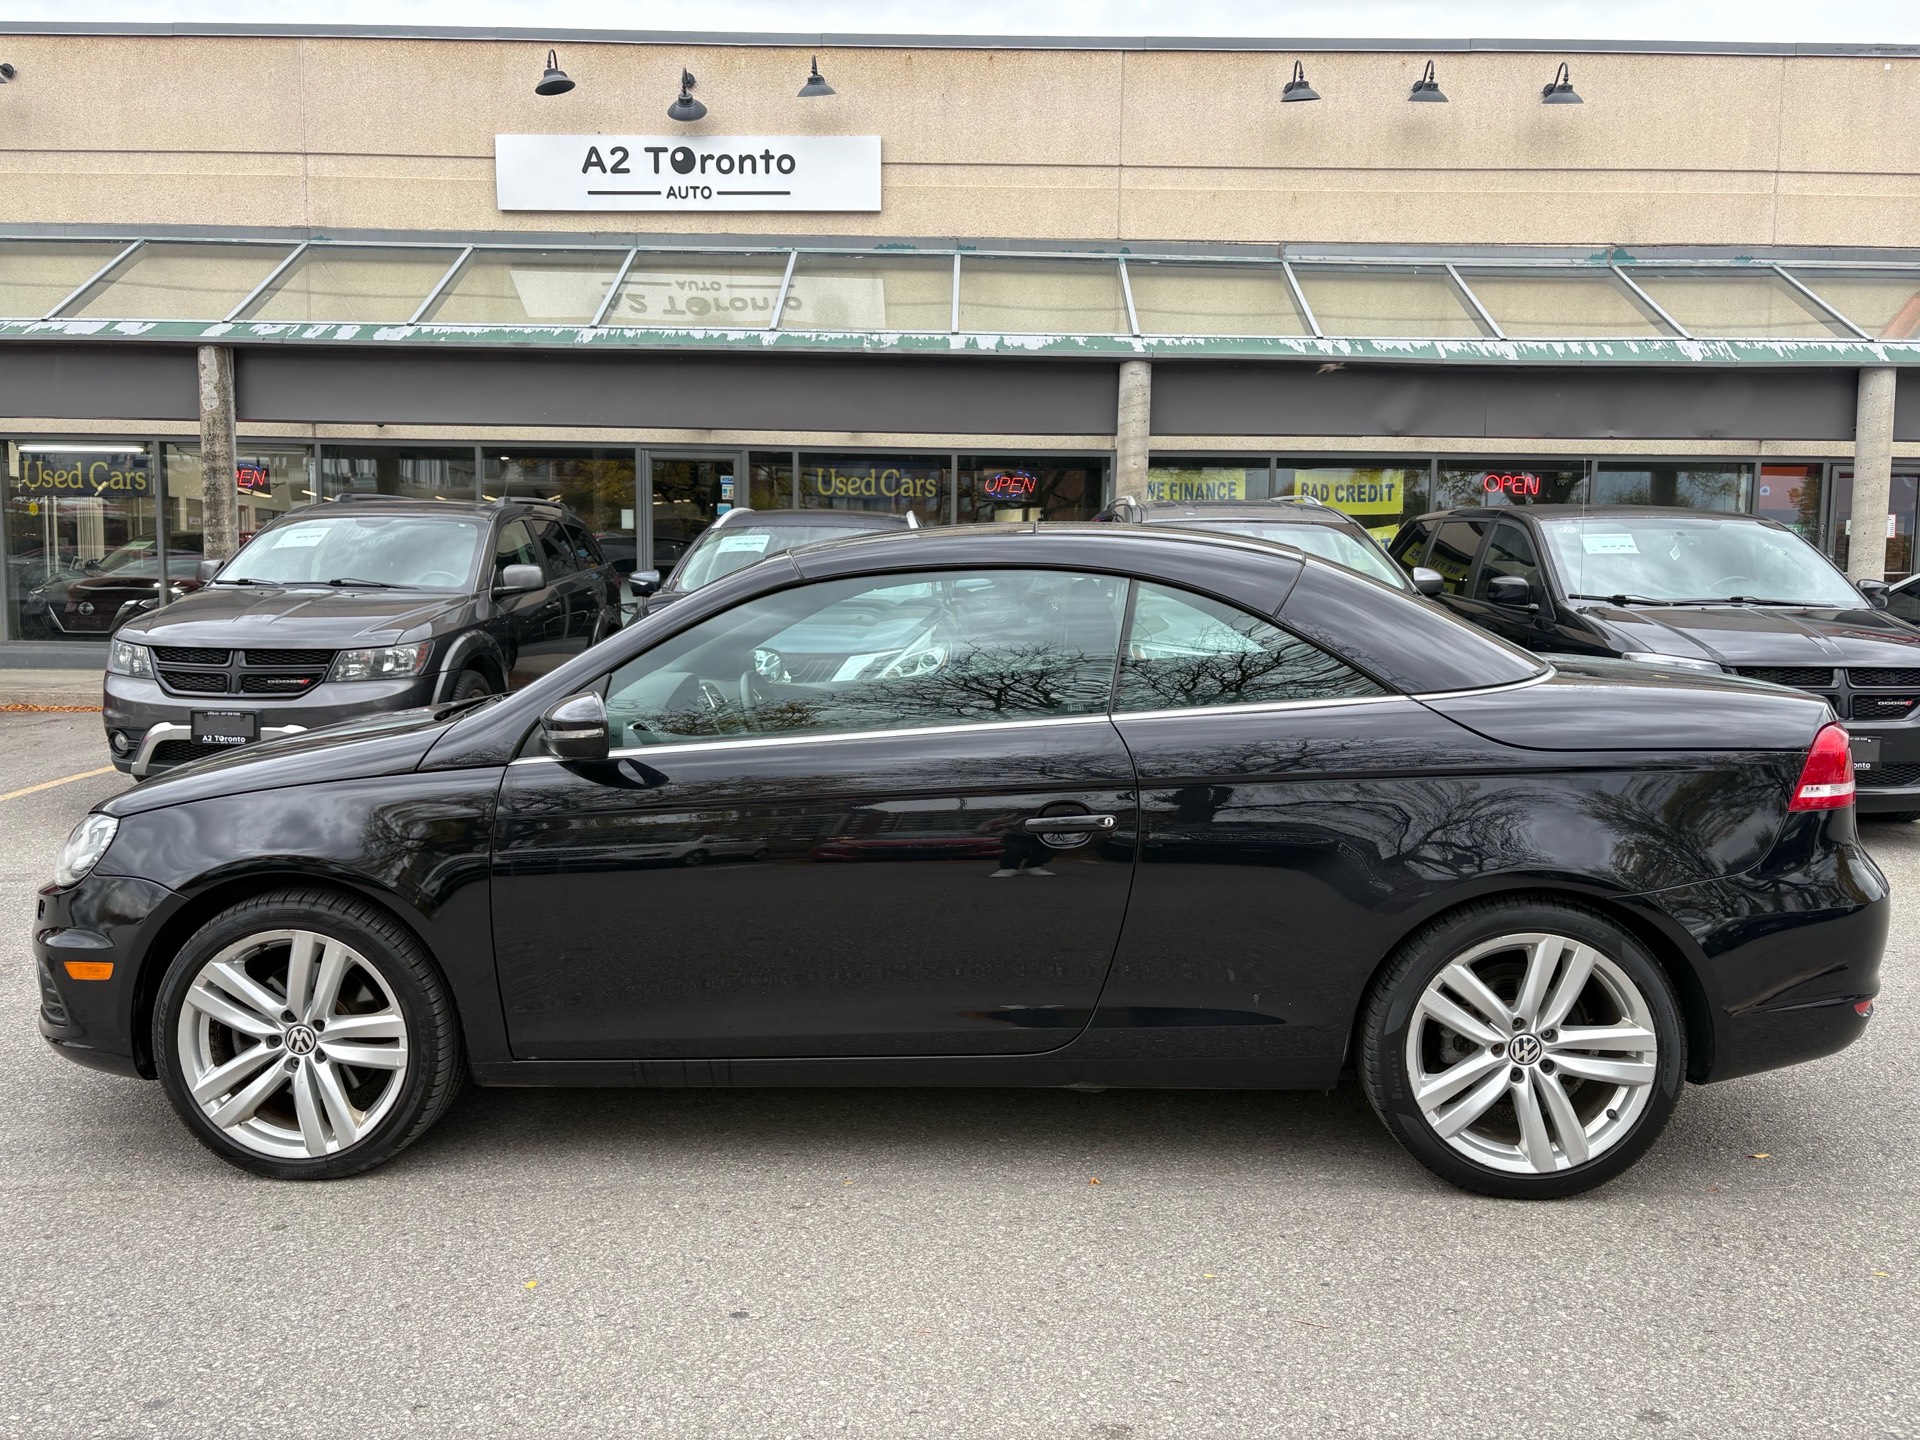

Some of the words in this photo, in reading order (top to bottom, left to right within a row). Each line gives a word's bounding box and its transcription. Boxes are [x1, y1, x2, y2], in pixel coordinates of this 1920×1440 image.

[581, 145, 631, 174] A2
[666, 185, 713, 200] AUTO
[22, 460, 84, 489] Used
[88, 461, 147, 491] Cars
[235, 469, 267, 487] EN
[816, 467, 877, 496] Used
[880, 468, 937, 498] Cars
[984, 476, 1037, 494] OPEN
[1483, 474, 1540, 495] OPEN
[1168, 480, 1237, 501] FINANCE
[1300, 482, 1330, 502] BAD
[1334, 483, 1395, 503] CREDIT
[202, 734, 213, 742] A2
